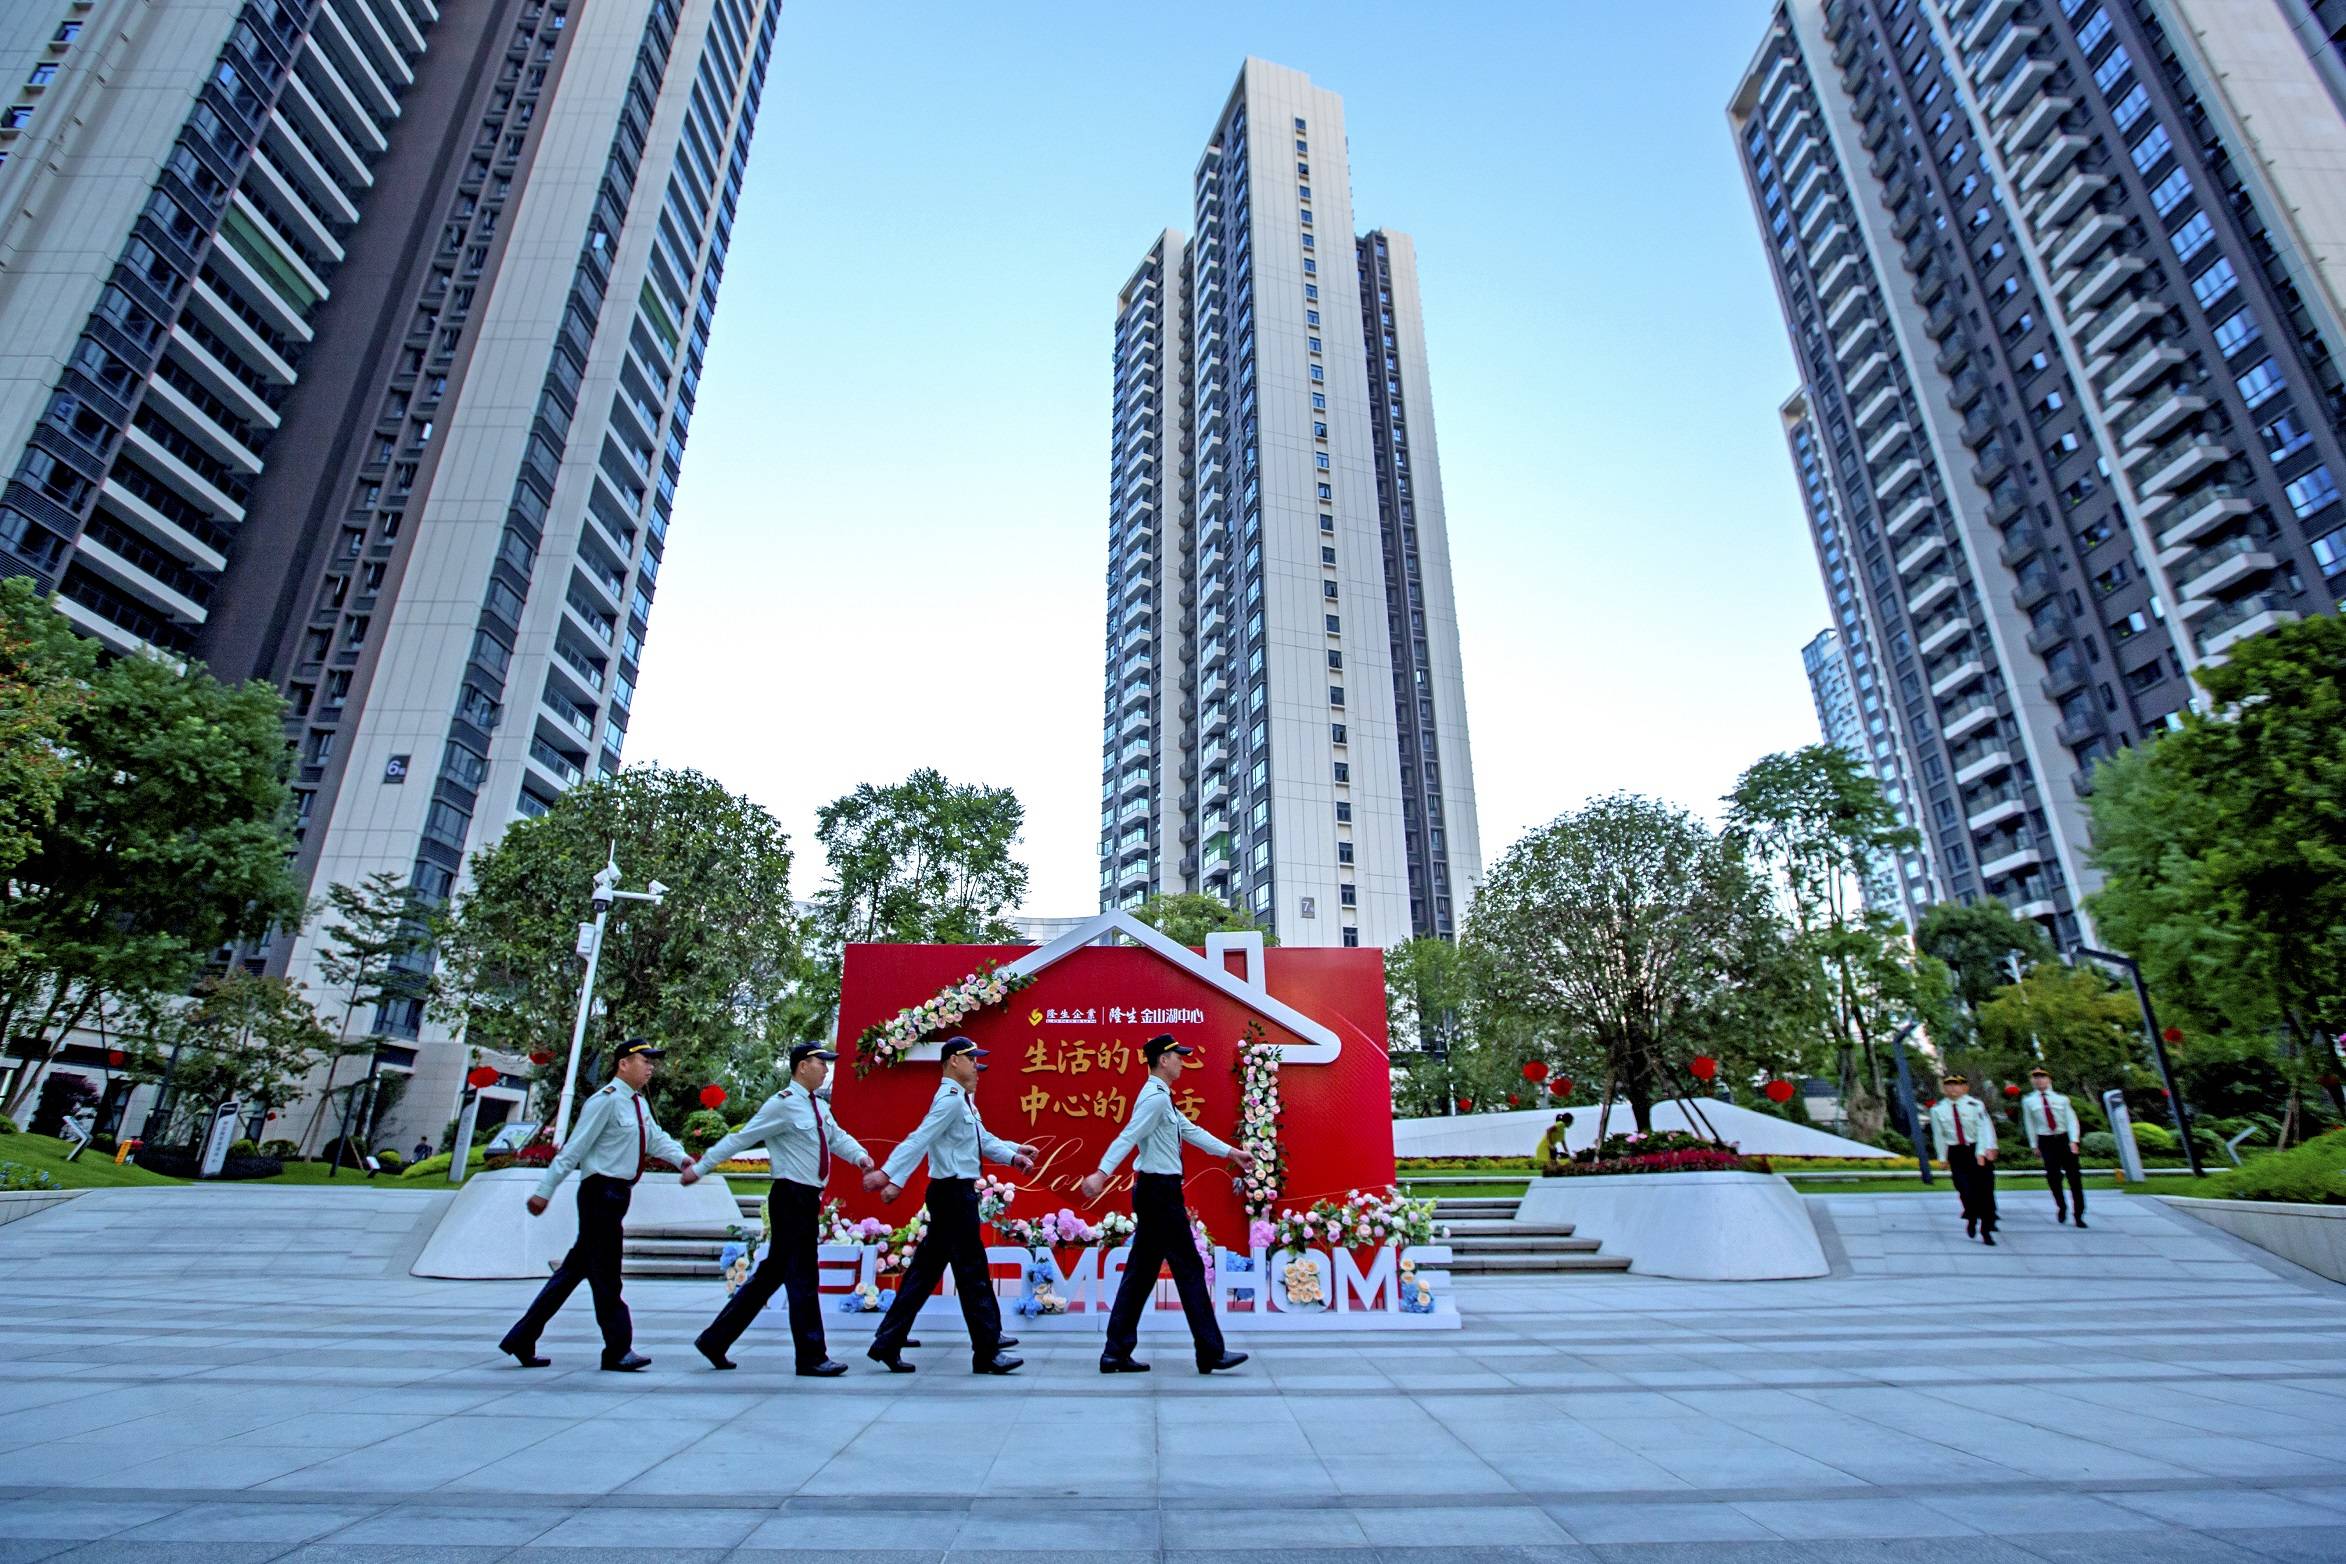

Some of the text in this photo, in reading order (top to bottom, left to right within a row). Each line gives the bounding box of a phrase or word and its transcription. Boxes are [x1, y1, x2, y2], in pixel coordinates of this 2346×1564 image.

[1021, 1038, 1206, 1076] 生活的心
[1020, 1084, 1206, 1128] 中心的活
[1213, 1245, 1453, 1315] HOME
